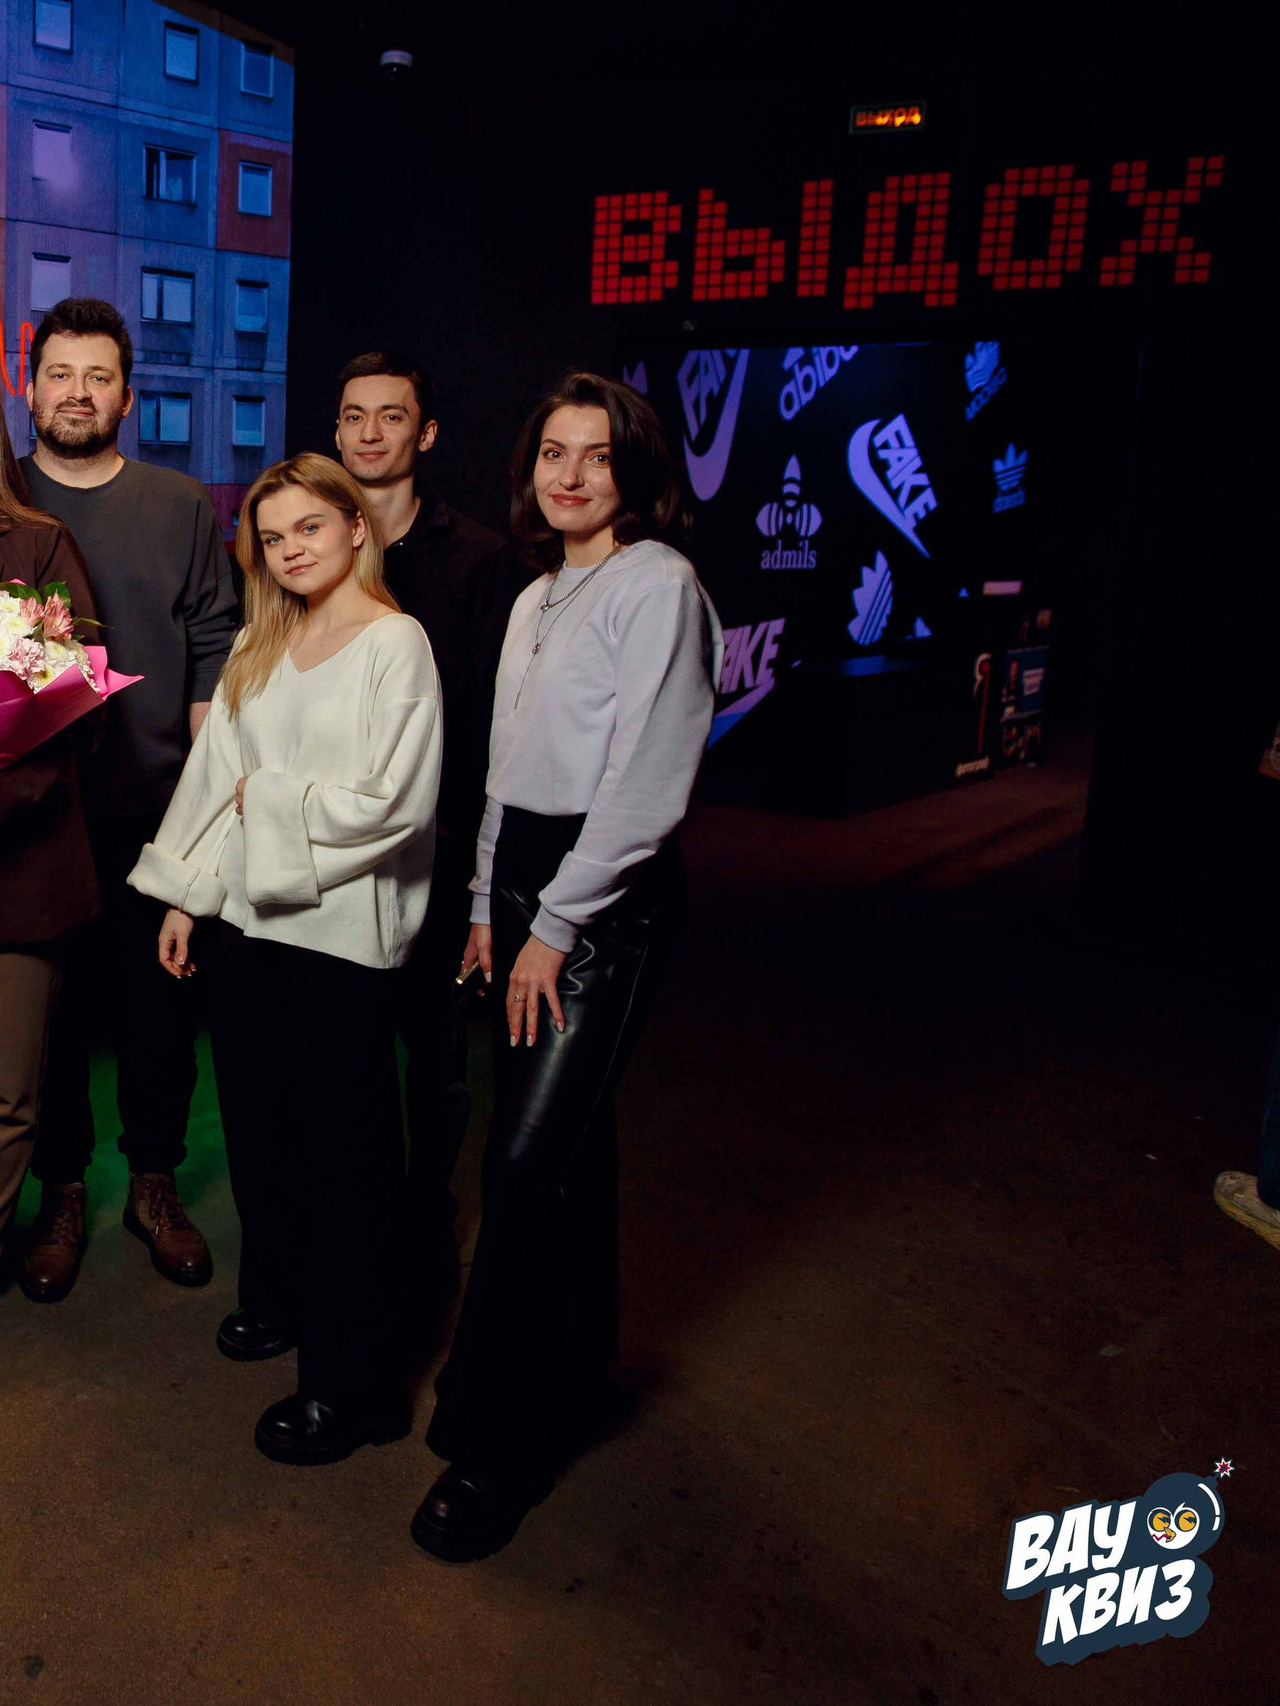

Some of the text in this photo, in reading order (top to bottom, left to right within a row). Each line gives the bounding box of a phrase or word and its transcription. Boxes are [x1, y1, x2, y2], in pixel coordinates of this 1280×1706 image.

[590, 156, 1224, 309] ВЫДОХ
[872, 413, 938, 531] FAKE
[760, 540, 818, 570] admils
[720, 617, 787, 695] AKE
